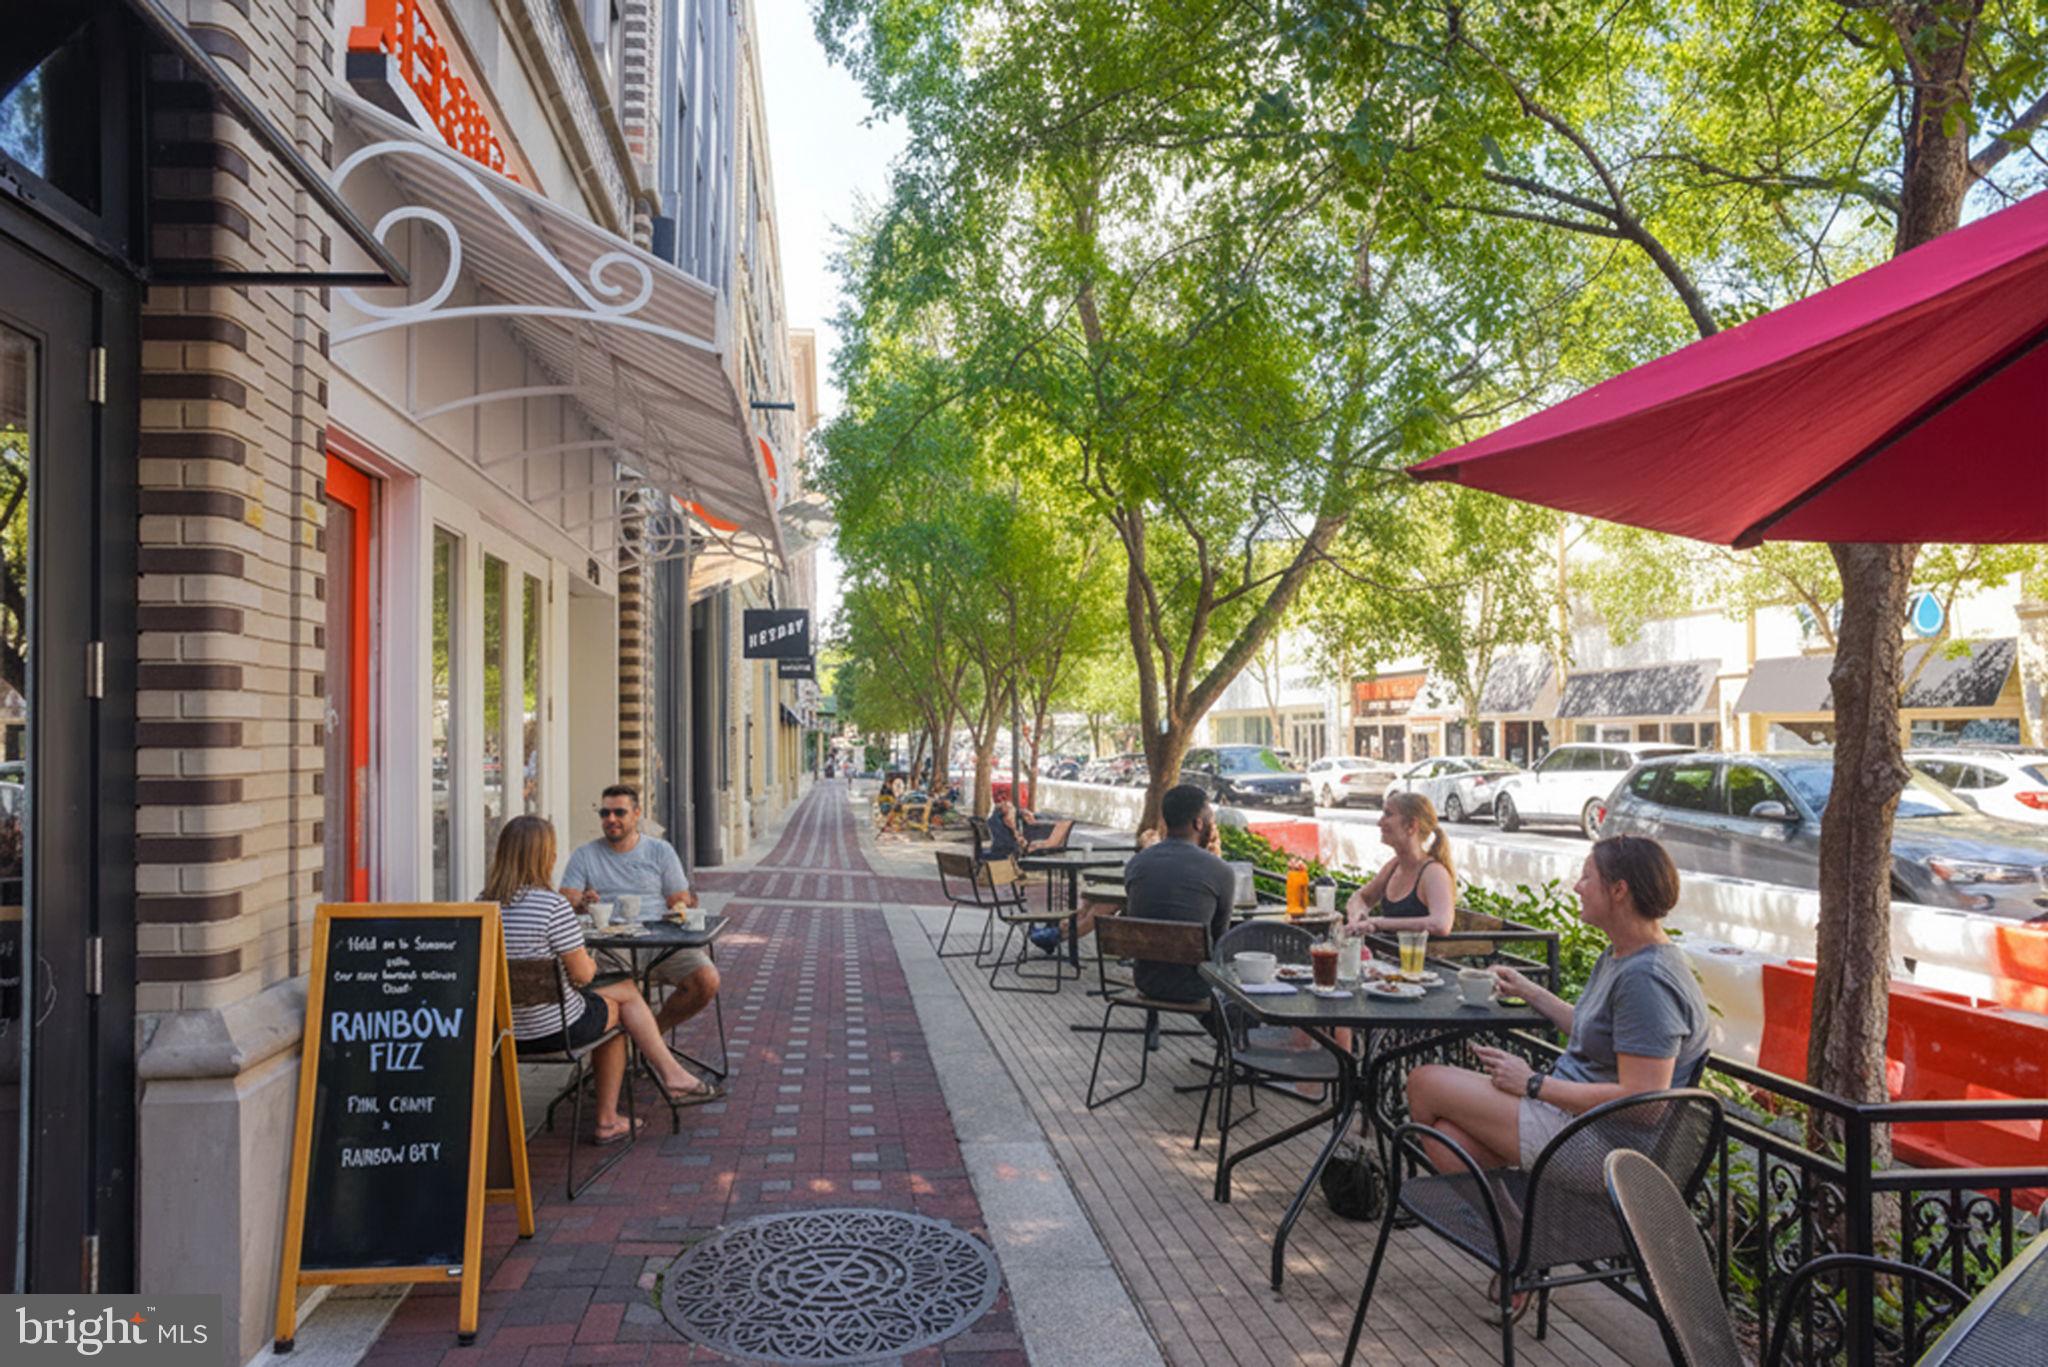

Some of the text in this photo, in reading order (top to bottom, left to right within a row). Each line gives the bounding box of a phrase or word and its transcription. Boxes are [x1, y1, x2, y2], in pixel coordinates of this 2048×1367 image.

[749, 618, 804, 648] HEYDAY
[331, 1007, 464, 1042] RAINBOW
[369, 1041, 425, 1072] FIZZ
